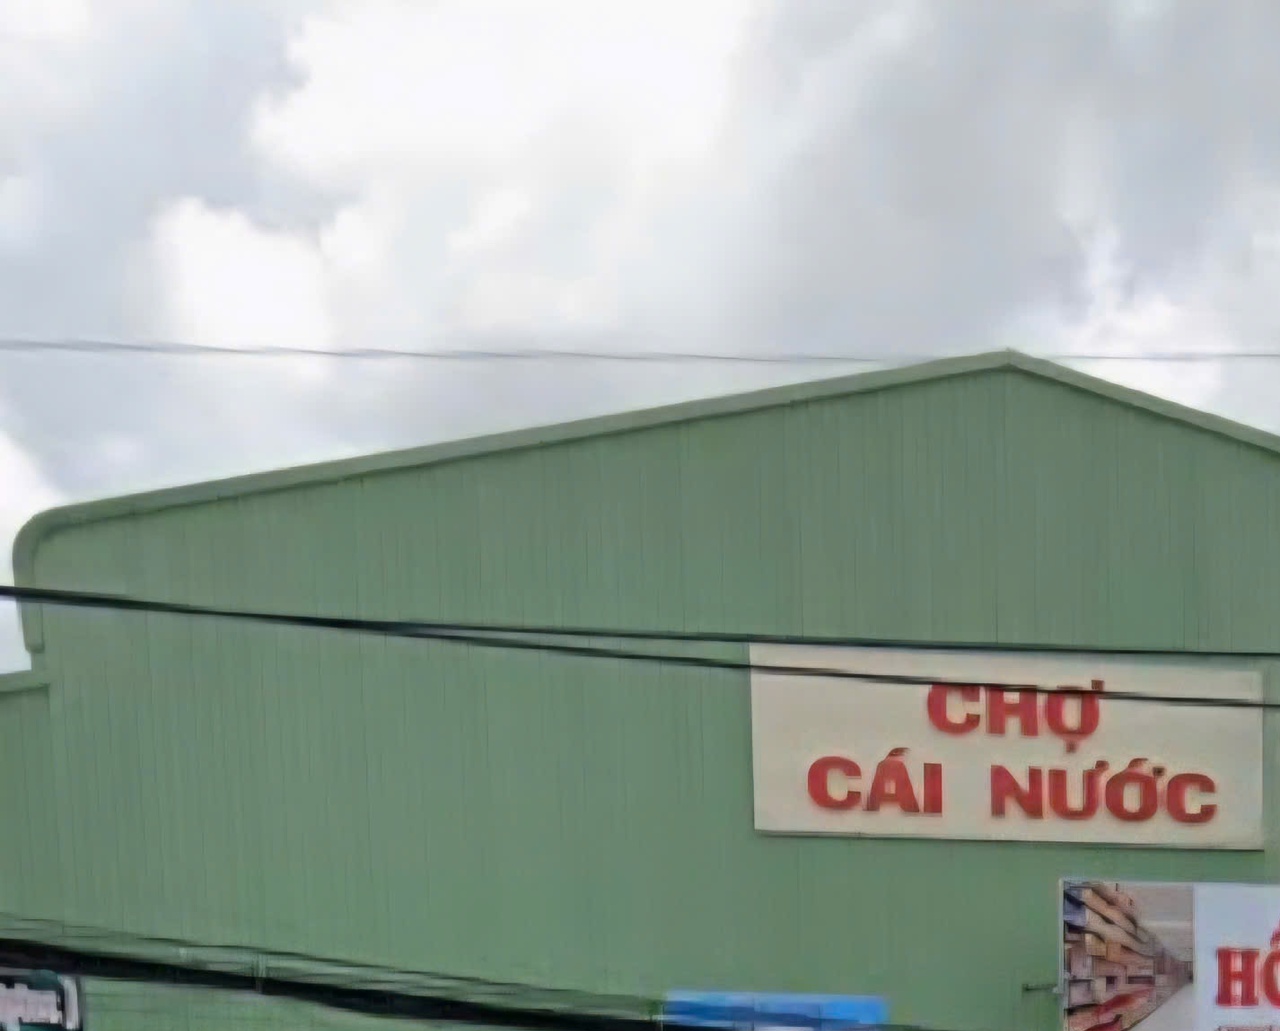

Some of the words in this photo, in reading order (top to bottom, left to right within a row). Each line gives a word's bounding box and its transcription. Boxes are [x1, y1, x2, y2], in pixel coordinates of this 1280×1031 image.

[926, 679, 1105, 752] CHỢ
[807, 747, 943, 816] CÁI
[990, 757, 1218, 824] NƯỚC
